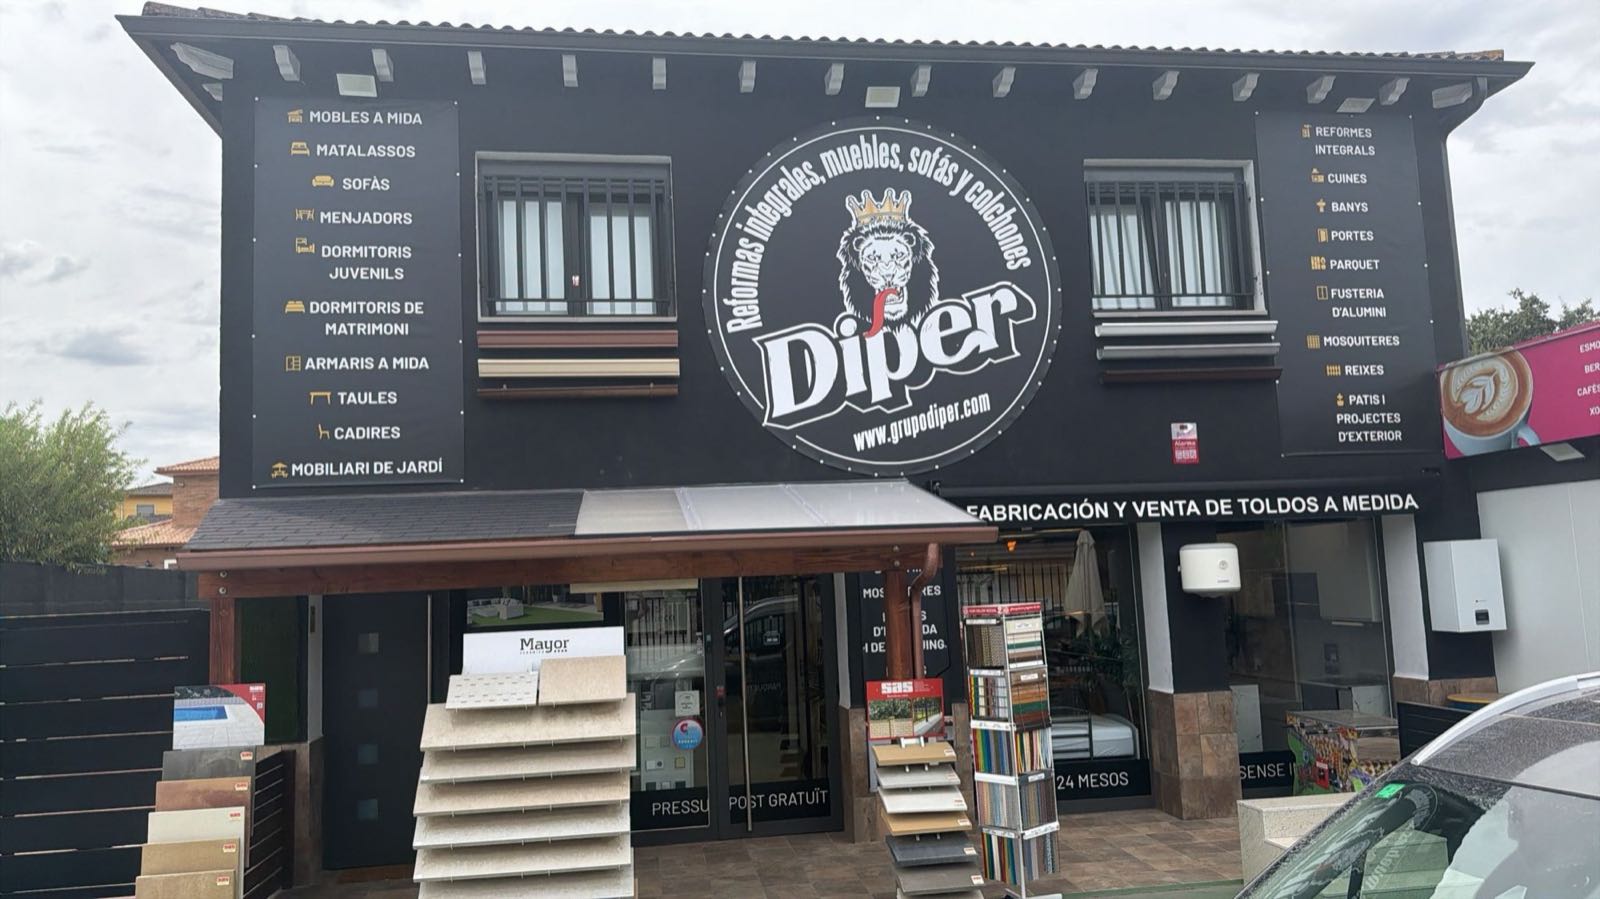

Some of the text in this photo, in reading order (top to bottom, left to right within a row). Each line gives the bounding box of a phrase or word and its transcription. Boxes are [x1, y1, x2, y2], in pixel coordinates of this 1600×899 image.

[309, 111, 423, 125] MOBLES A MIDA
[1315, 126, 1372, 138] REFORMES
[316, 143, 416, 157] MATALASSOS
[1315, 144, 1376, 156] INTEGRALS
[342, 175, 390, 191] SOFÀS
[1327, 173, 1368, 184] CUINES
[1331, 201, 1369, 213] BANYS
[319, 211, 413, 224] MENJADORS
[726, 134, 1031, 333] Reformas integrales, muebles, sofás y colchones
[1331, 230, 1374, 241] PORTES
[321, 245, 412, 258] DORMITORIS
[1329, 259, 1380, 271] PARQUET
[328, 266, 405, 280] JUVENILS
[1331, 288, 1385, 299] FUSTERIA
[309, 301, 424, 314] DORMITORIS DE
[325, 322, 409, 336] MATRIMONI
[1323, 335, 1400, 348] MOSQUITERES
[761, 285, 1020, 419] Diper
[304, 357, 429, 370] ARMARIS A MIDA
[1344, 364, 1385, 376] REIXES
[337, 391, 398, 405] TAULES
[1348, 394, 1380, 406] PATIS
[853, 392, 991, 452] www.grupodiper.com
[1336, 412, 1401, 425] PROJECTES
[334, 426, 401, 440] CADIRES
[291, 456, 443, 477] MOBILIARI DE JARDÍ
[966, 493, 1420, 522] FABRICACIÓN Y VENTA DE TOLDOS A MEDIDA
[520, 637, 570, 654] Mayor
[1056, 775, 1074, 790] 24
[1078, 771, 1129, 788] MESOS
[652, 787, 828, 816] PRESSU POST GRATUÏT
